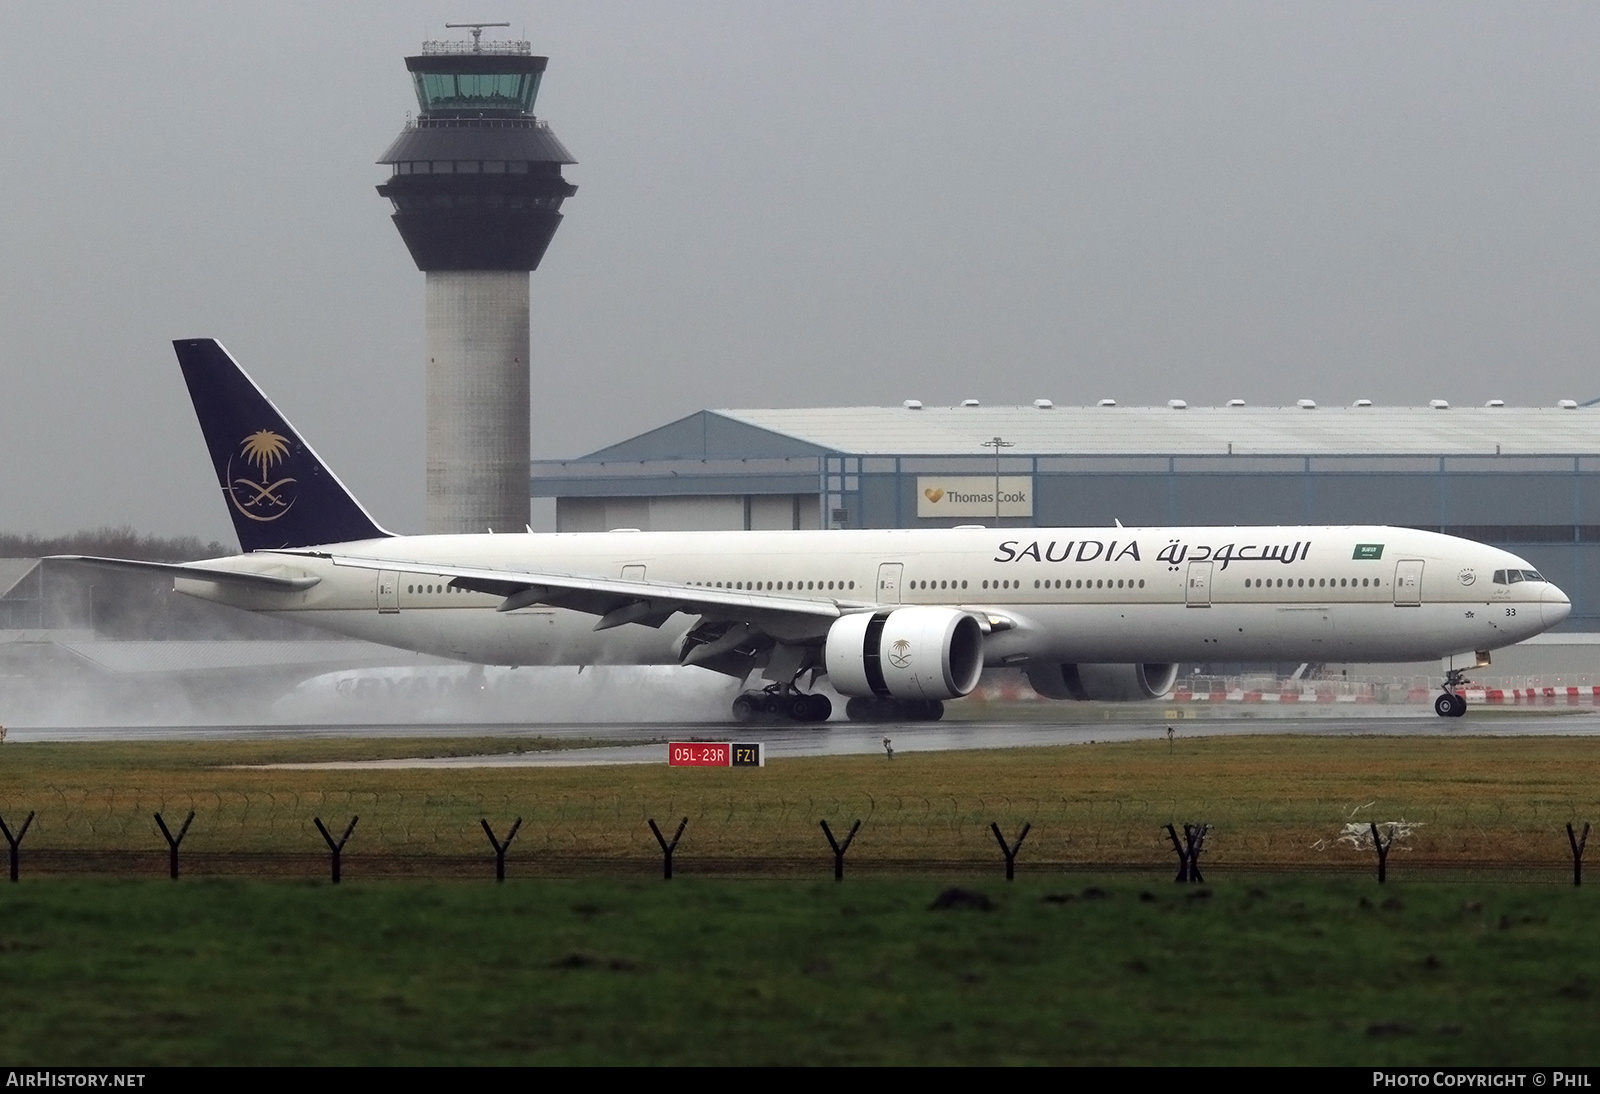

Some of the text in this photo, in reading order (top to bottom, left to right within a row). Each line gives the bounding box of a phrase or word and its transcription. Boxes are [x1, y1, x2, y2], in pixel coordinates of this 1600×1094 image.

[947, 491, 1026, 503] Thomas Cook
[993, 540, 1141, 563] SAUDIA
[1156, 538, 1311, 572] السعودية
[1505, 608, 1516, 617] 33
[674, 748, 724, 762] 05L-23R
